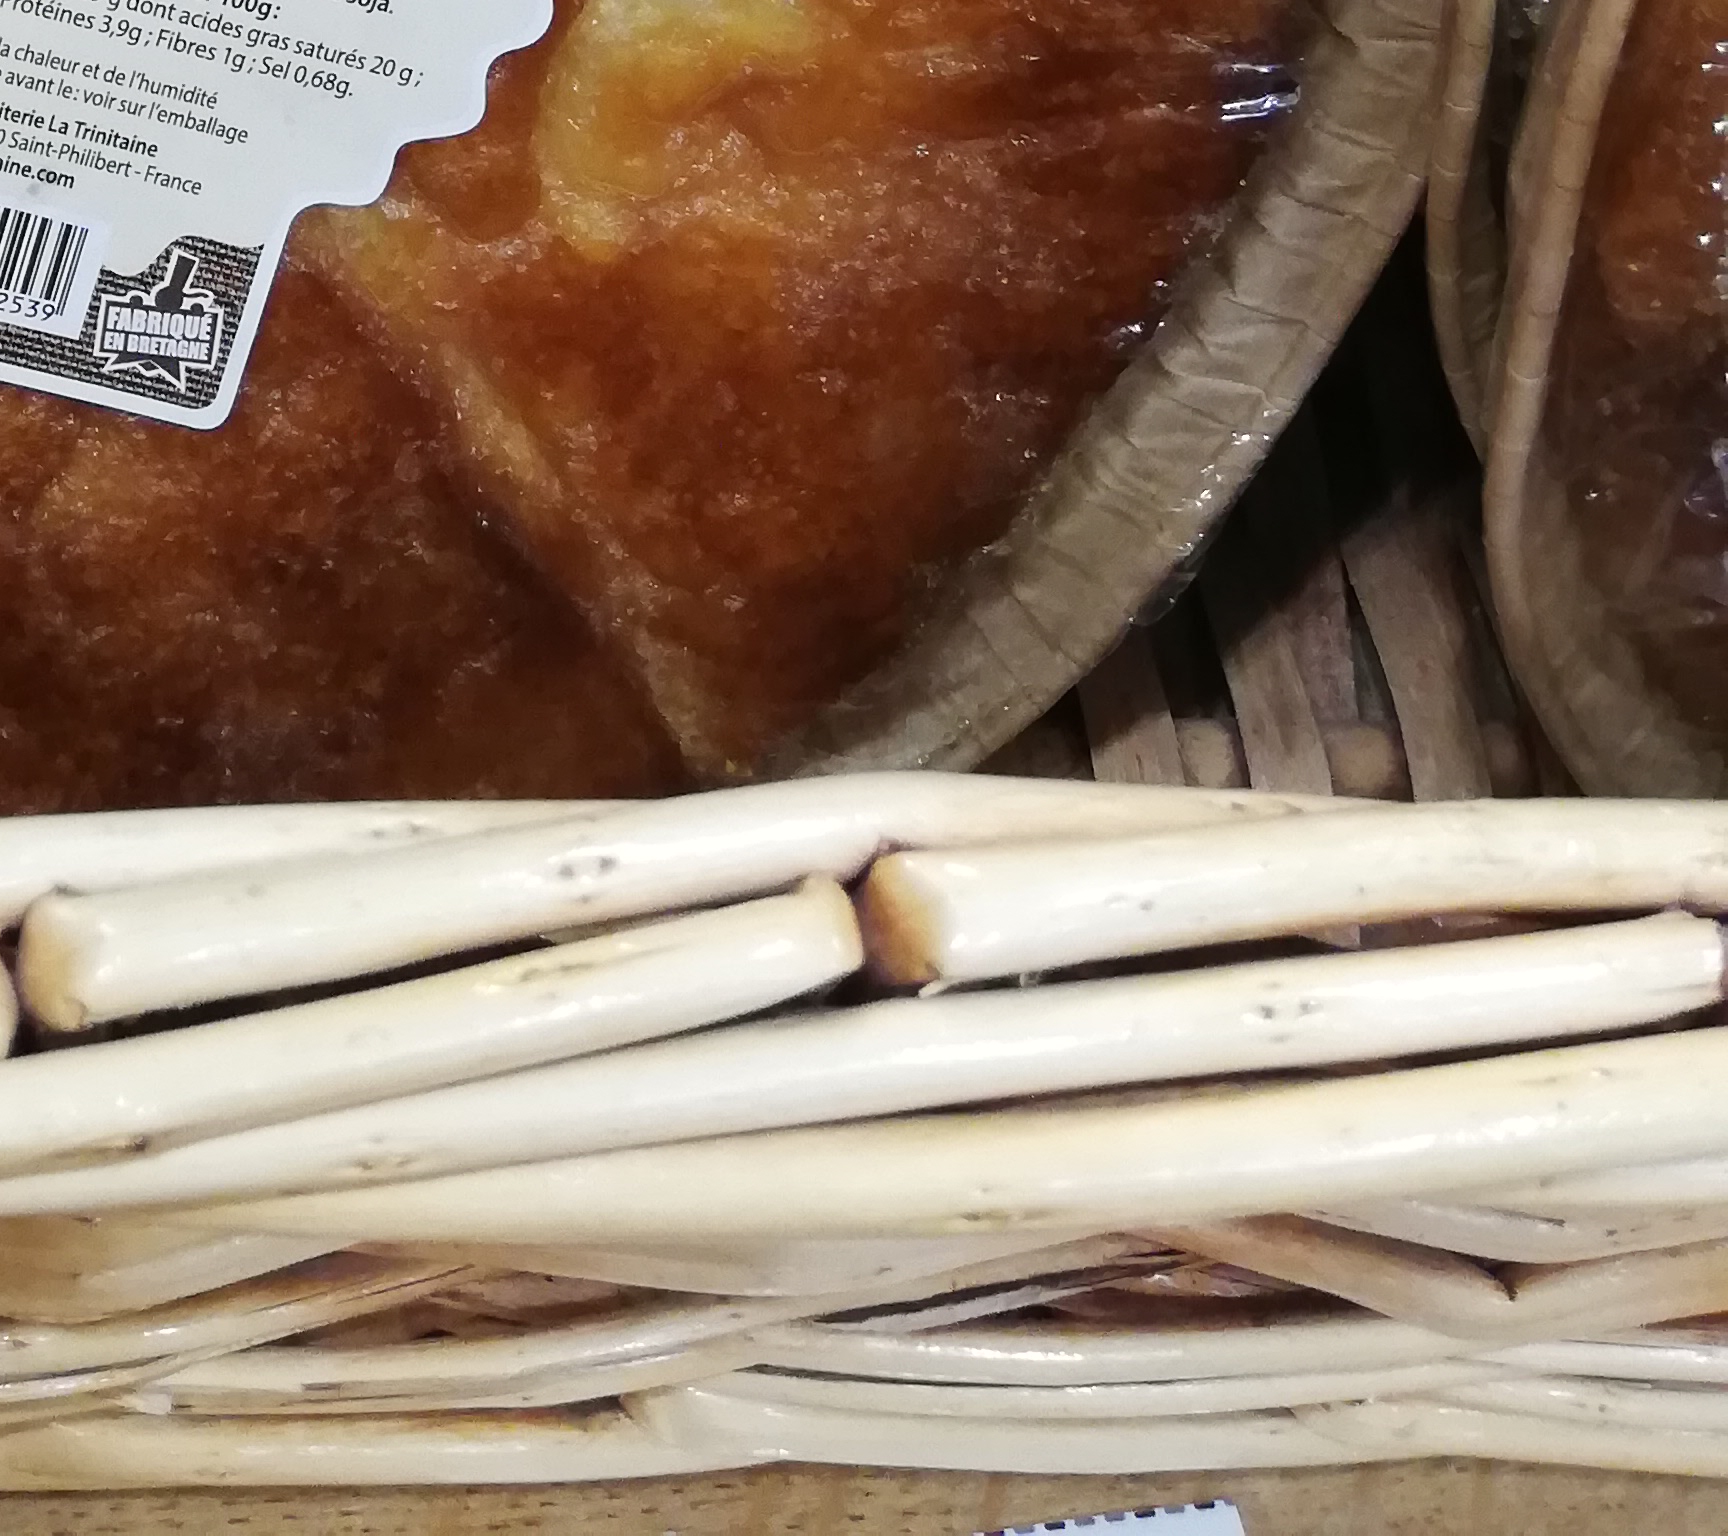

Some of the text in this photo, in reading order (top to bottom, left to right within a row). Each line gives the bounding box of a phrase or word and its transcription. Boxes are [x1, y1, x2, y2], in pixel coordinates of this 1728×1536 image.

[177, 9, 244, 39] acides
[244, 27, 291, 51] gras
[292, 39, 367, 70] saturés
[13, 42, 81, 74] chaleur
[81, 62, 100, 80] et
[102, 64, 126, 86] de
[154, 27, 217, 61] Fibres
[257, 55, 292, 80] Sel
[293, 64, 353, 99] 0,68g.
[3, 70, 55, 95] avant
[82, 88, 117, 110] voir
[116, 98, 147, 117] sur
[47, 113, 69, 136] La
[73, 119, 158, 158] Trinitaine
[6, 130, 132, 178] Saint-Philibert
[142, 164, 202, 195] France
[103, 330, 210, 361] EN BRETAGNE
[106, 305, 213, 341] FABRIQUÉ
